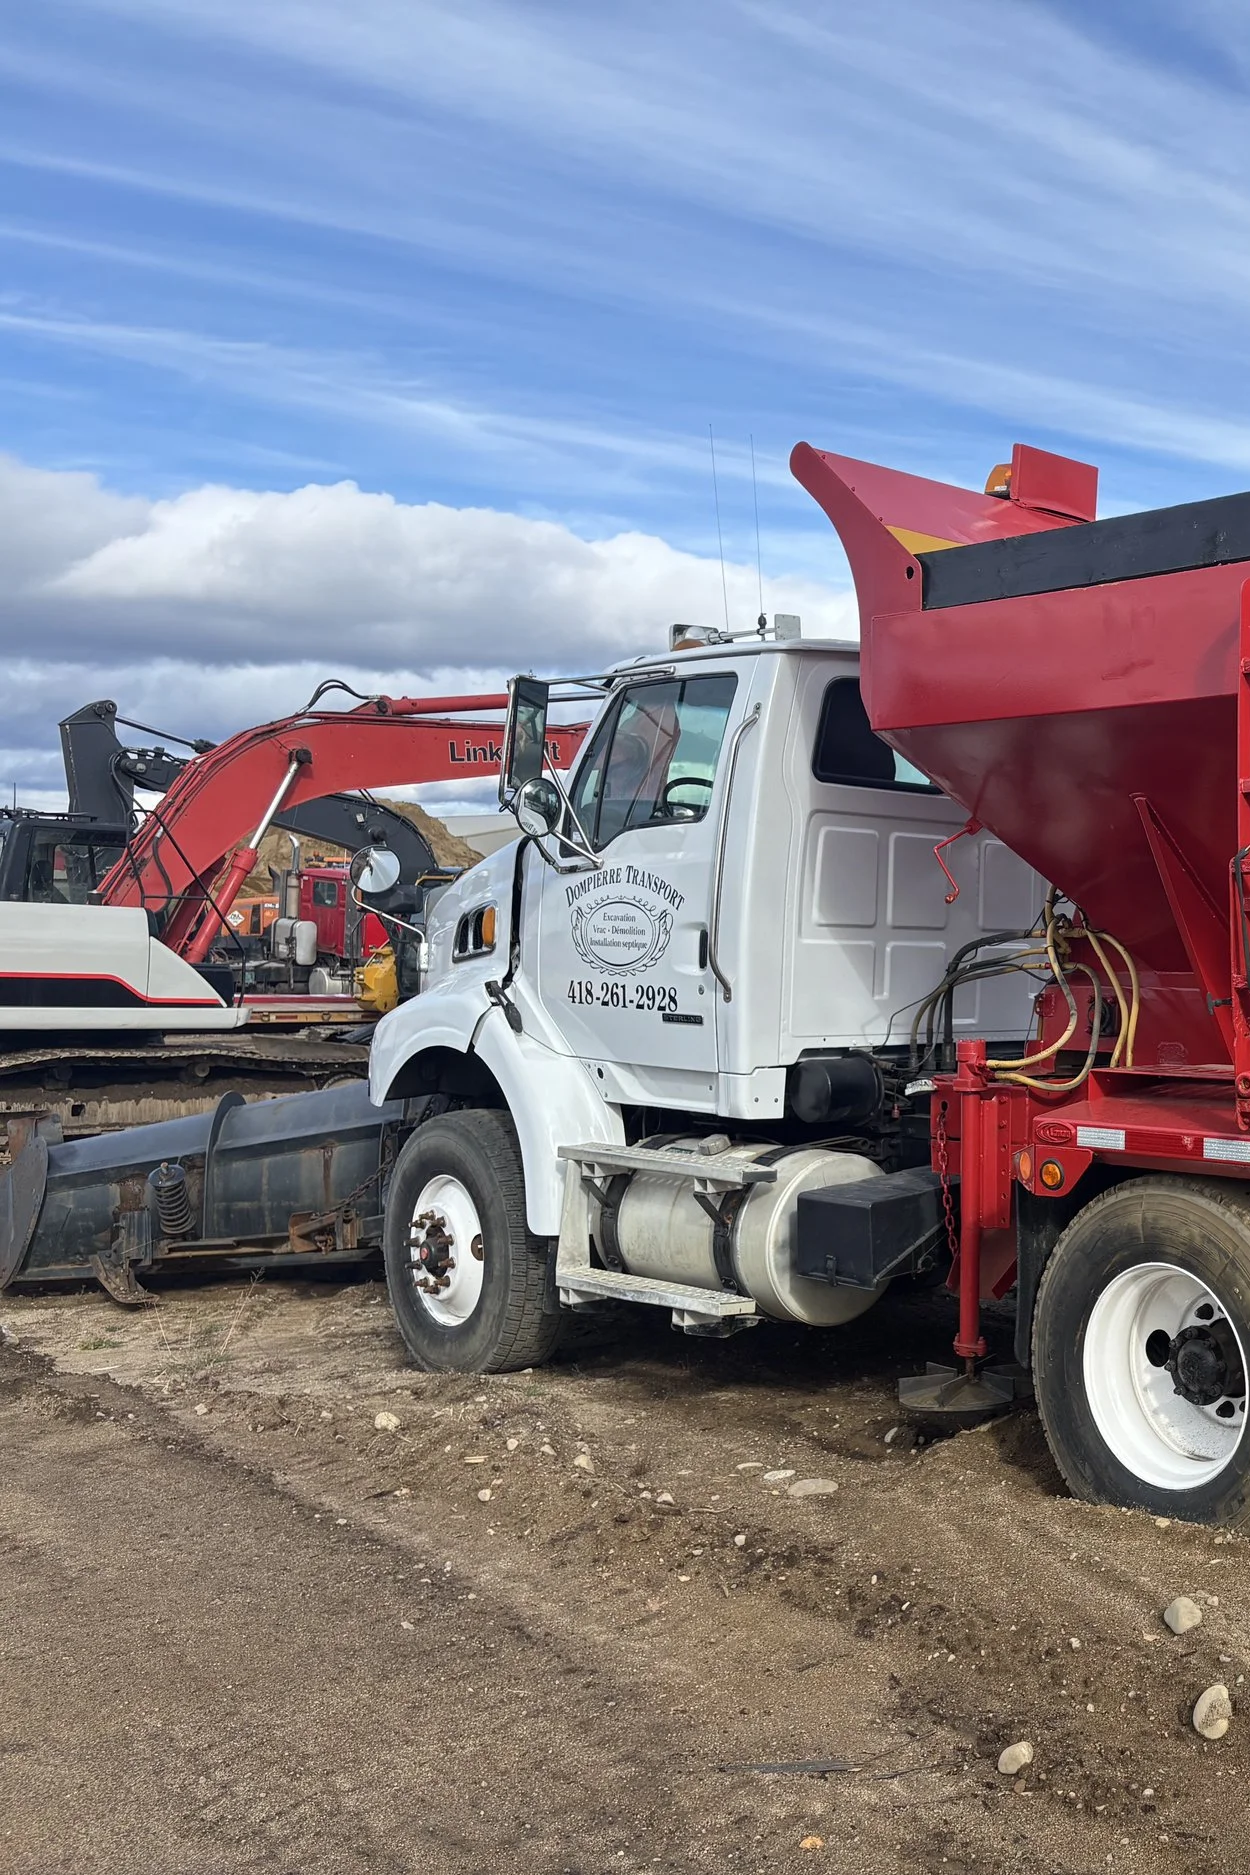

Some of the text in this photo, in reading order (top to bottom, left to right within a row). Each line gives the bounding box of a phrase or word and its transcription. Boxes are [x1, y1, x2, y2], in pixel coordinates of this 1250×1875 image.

[449, 740, 560, 763] Linklt
[565, 865, 685, 911] DOMPIERRE TRANSPORT
[603, 912, 636, 922] Excavation
[592, 924, 606, 934] Vrac
[611, 925, 646, 936] Démolition
[590, 937, 648, 951] Installation septique
[568, 980, 678, 1012] 418-261-2928
